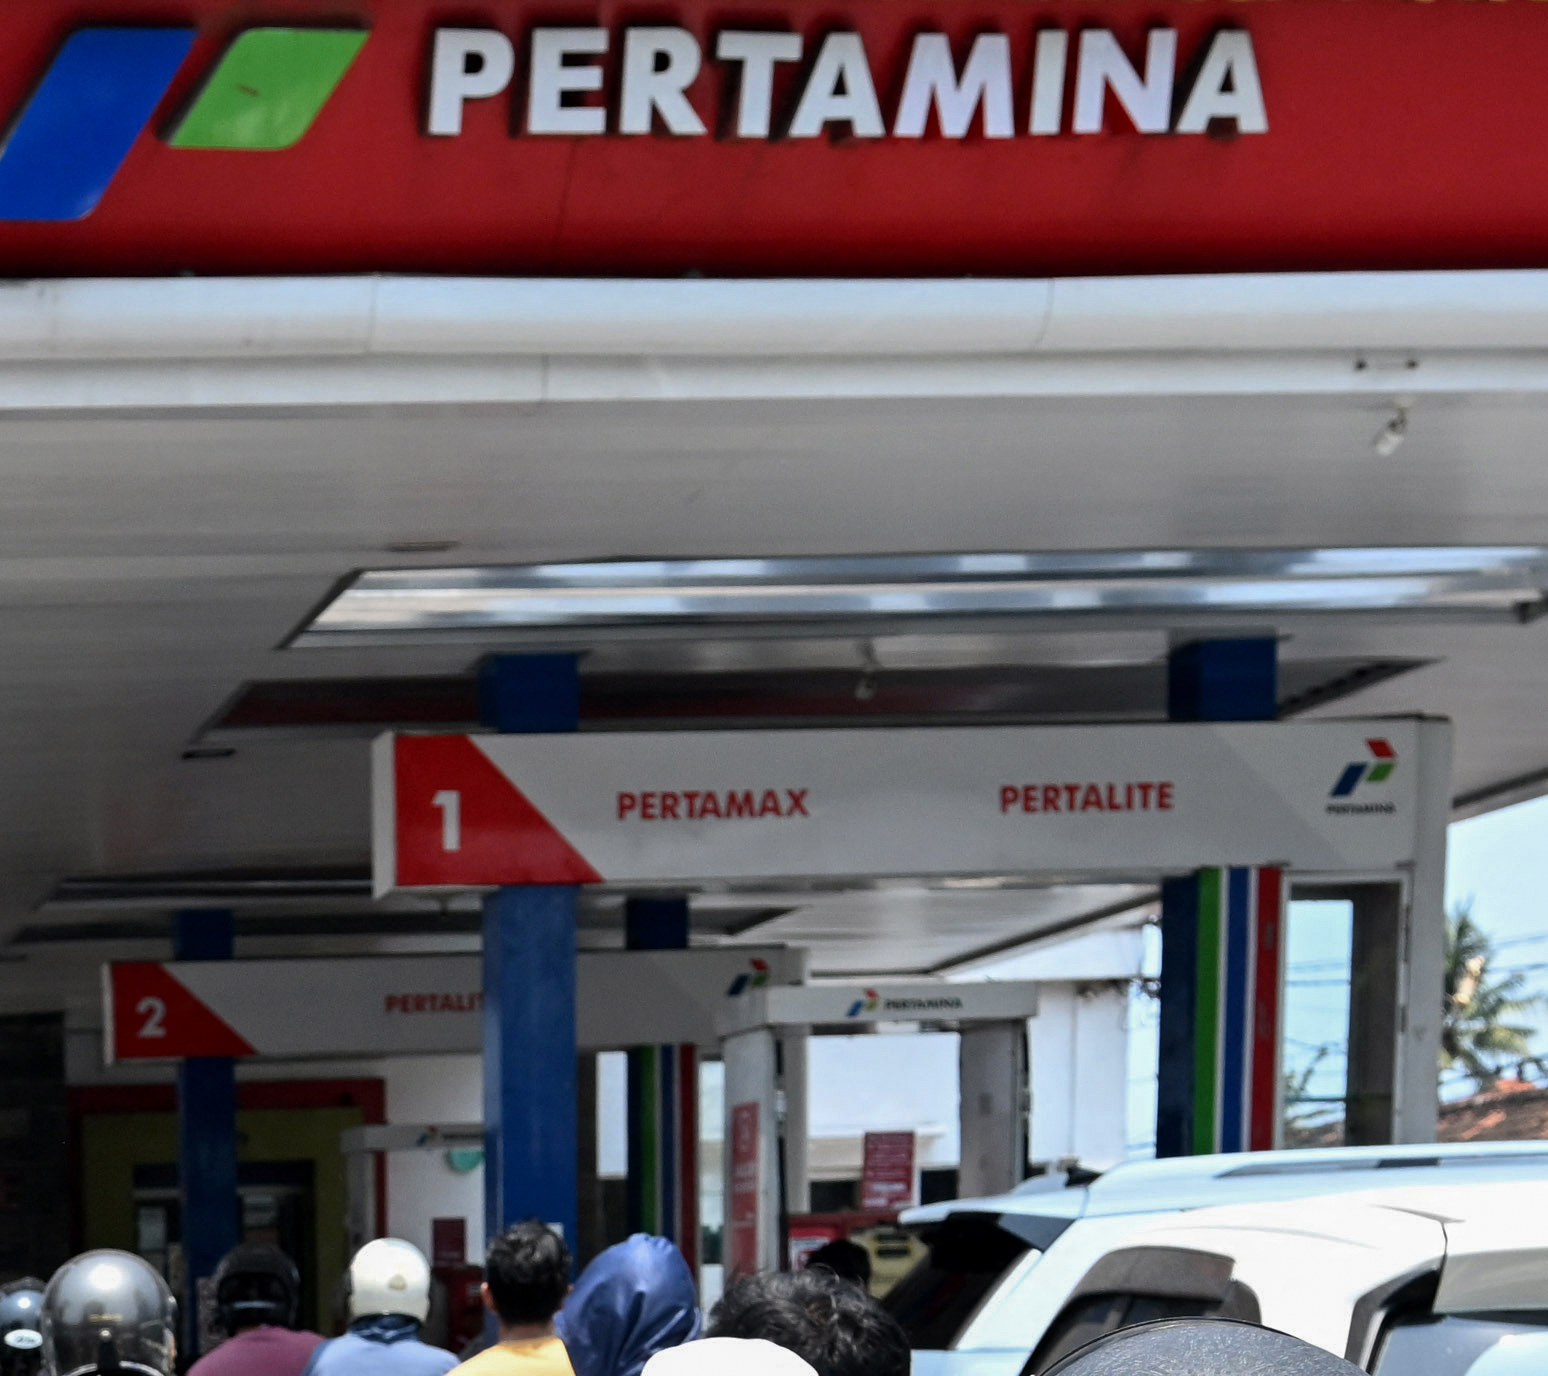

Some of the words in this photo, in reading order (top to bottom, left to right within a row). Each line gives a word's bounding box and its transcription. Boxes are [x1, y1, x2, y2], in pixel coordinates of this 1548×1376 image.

[427, 27, 1269, 139] PERTAMINA
[617, 787, 809, 820] PERTAMAX
[999, 781, 1175, 814] PERTALITE
[432, 789, 461, 851] 1
[136, 996, 167, 1037] 2
[885, 998, 963, 1011] PERTAMINA
